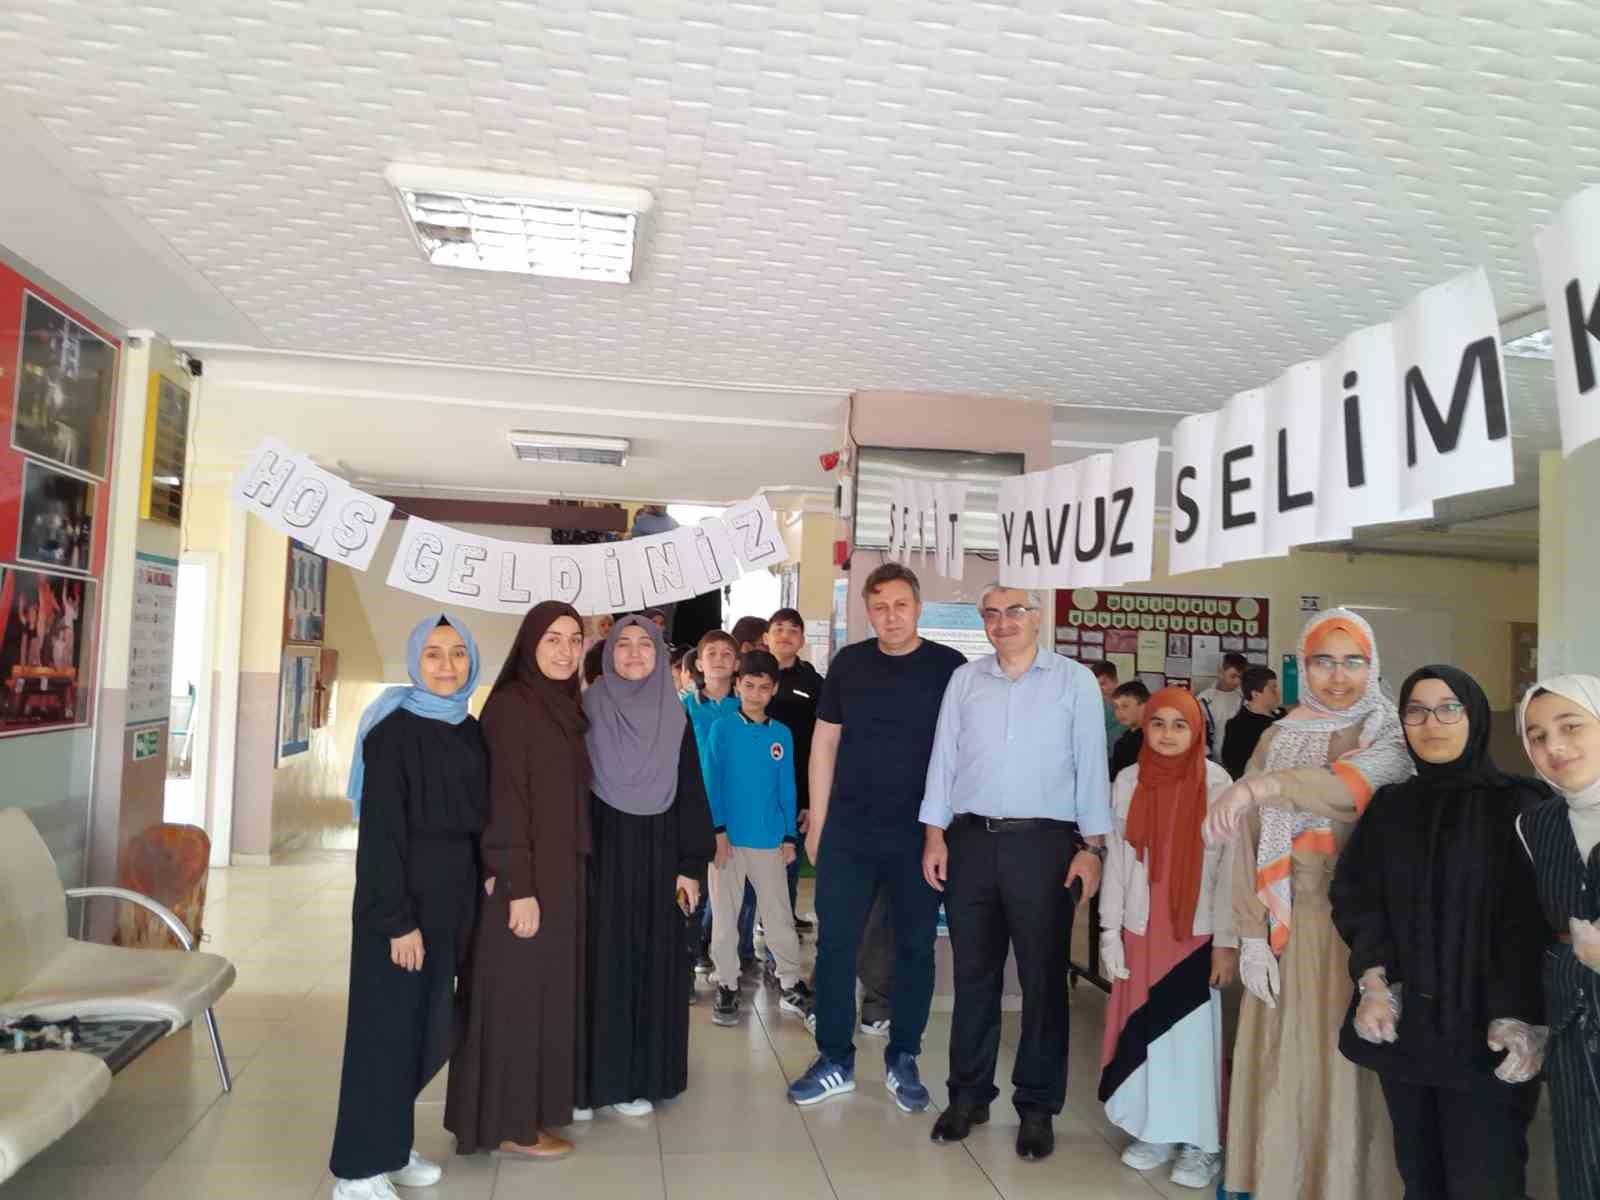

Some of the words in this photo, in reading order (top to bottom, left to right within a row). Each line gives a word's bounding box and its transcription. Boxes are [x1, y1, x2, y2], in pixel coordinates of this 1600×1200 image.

[242, 449, 377, 558] HOŞ
[403, 508, 777, 607] GELDİNİZ
[1002, 486, 1134, 568] YAVUZ
[1174, 335, 1508, 545] SELİM
